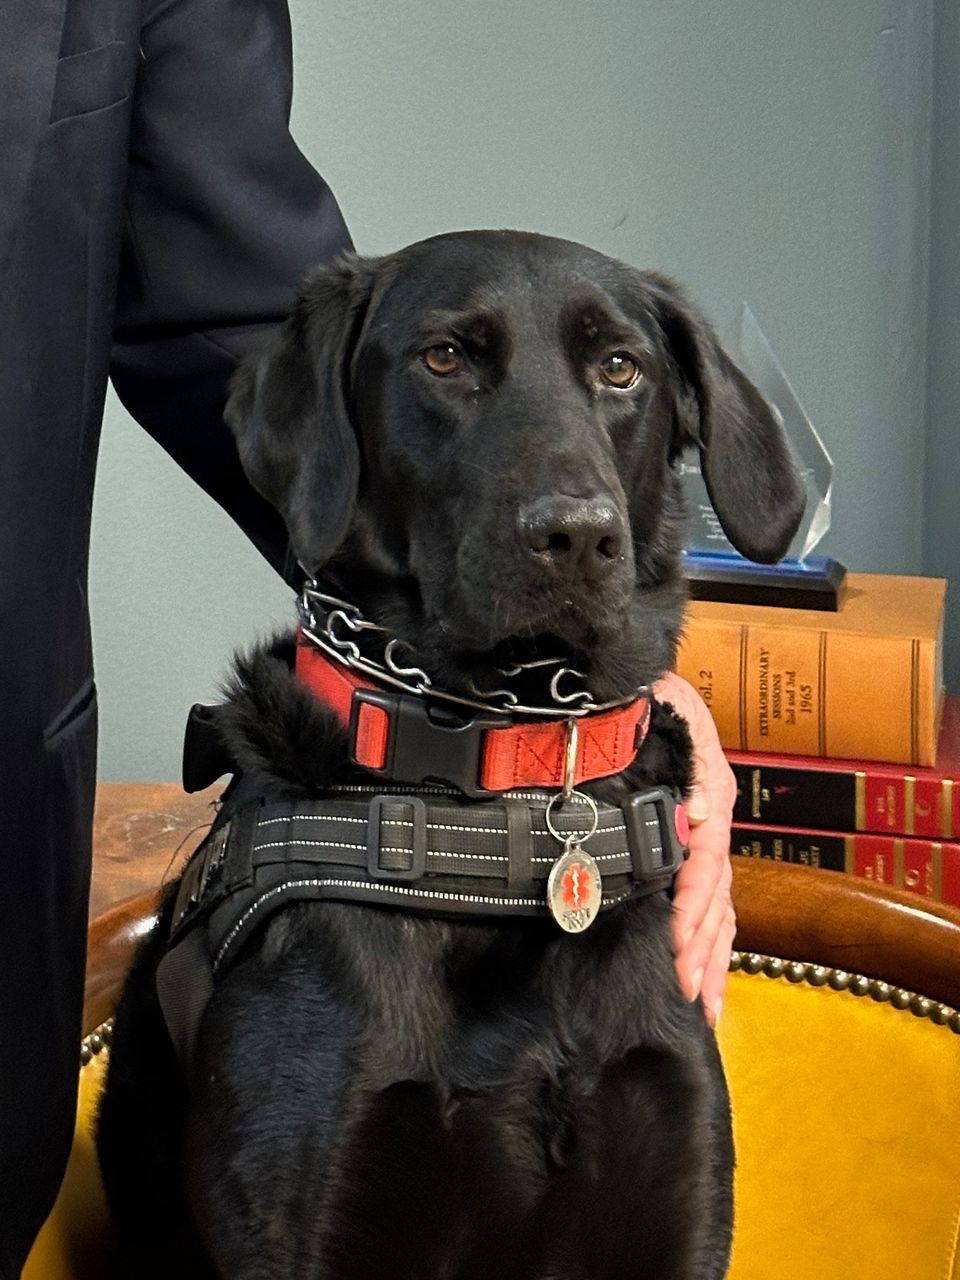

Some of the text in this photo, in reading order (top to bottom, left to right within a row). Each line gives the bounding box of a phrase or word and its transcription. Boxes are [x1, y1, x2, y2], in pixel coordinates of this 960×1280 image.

[699, 670, 713, 679] 2
[759, 648, 769, 736] EXTRAORDINARY
[772, 673, 782, 720] SESSIONS
[785, 671, 795, 724] 2nd and 3rd
[800, 684, 812, 713] 1965
